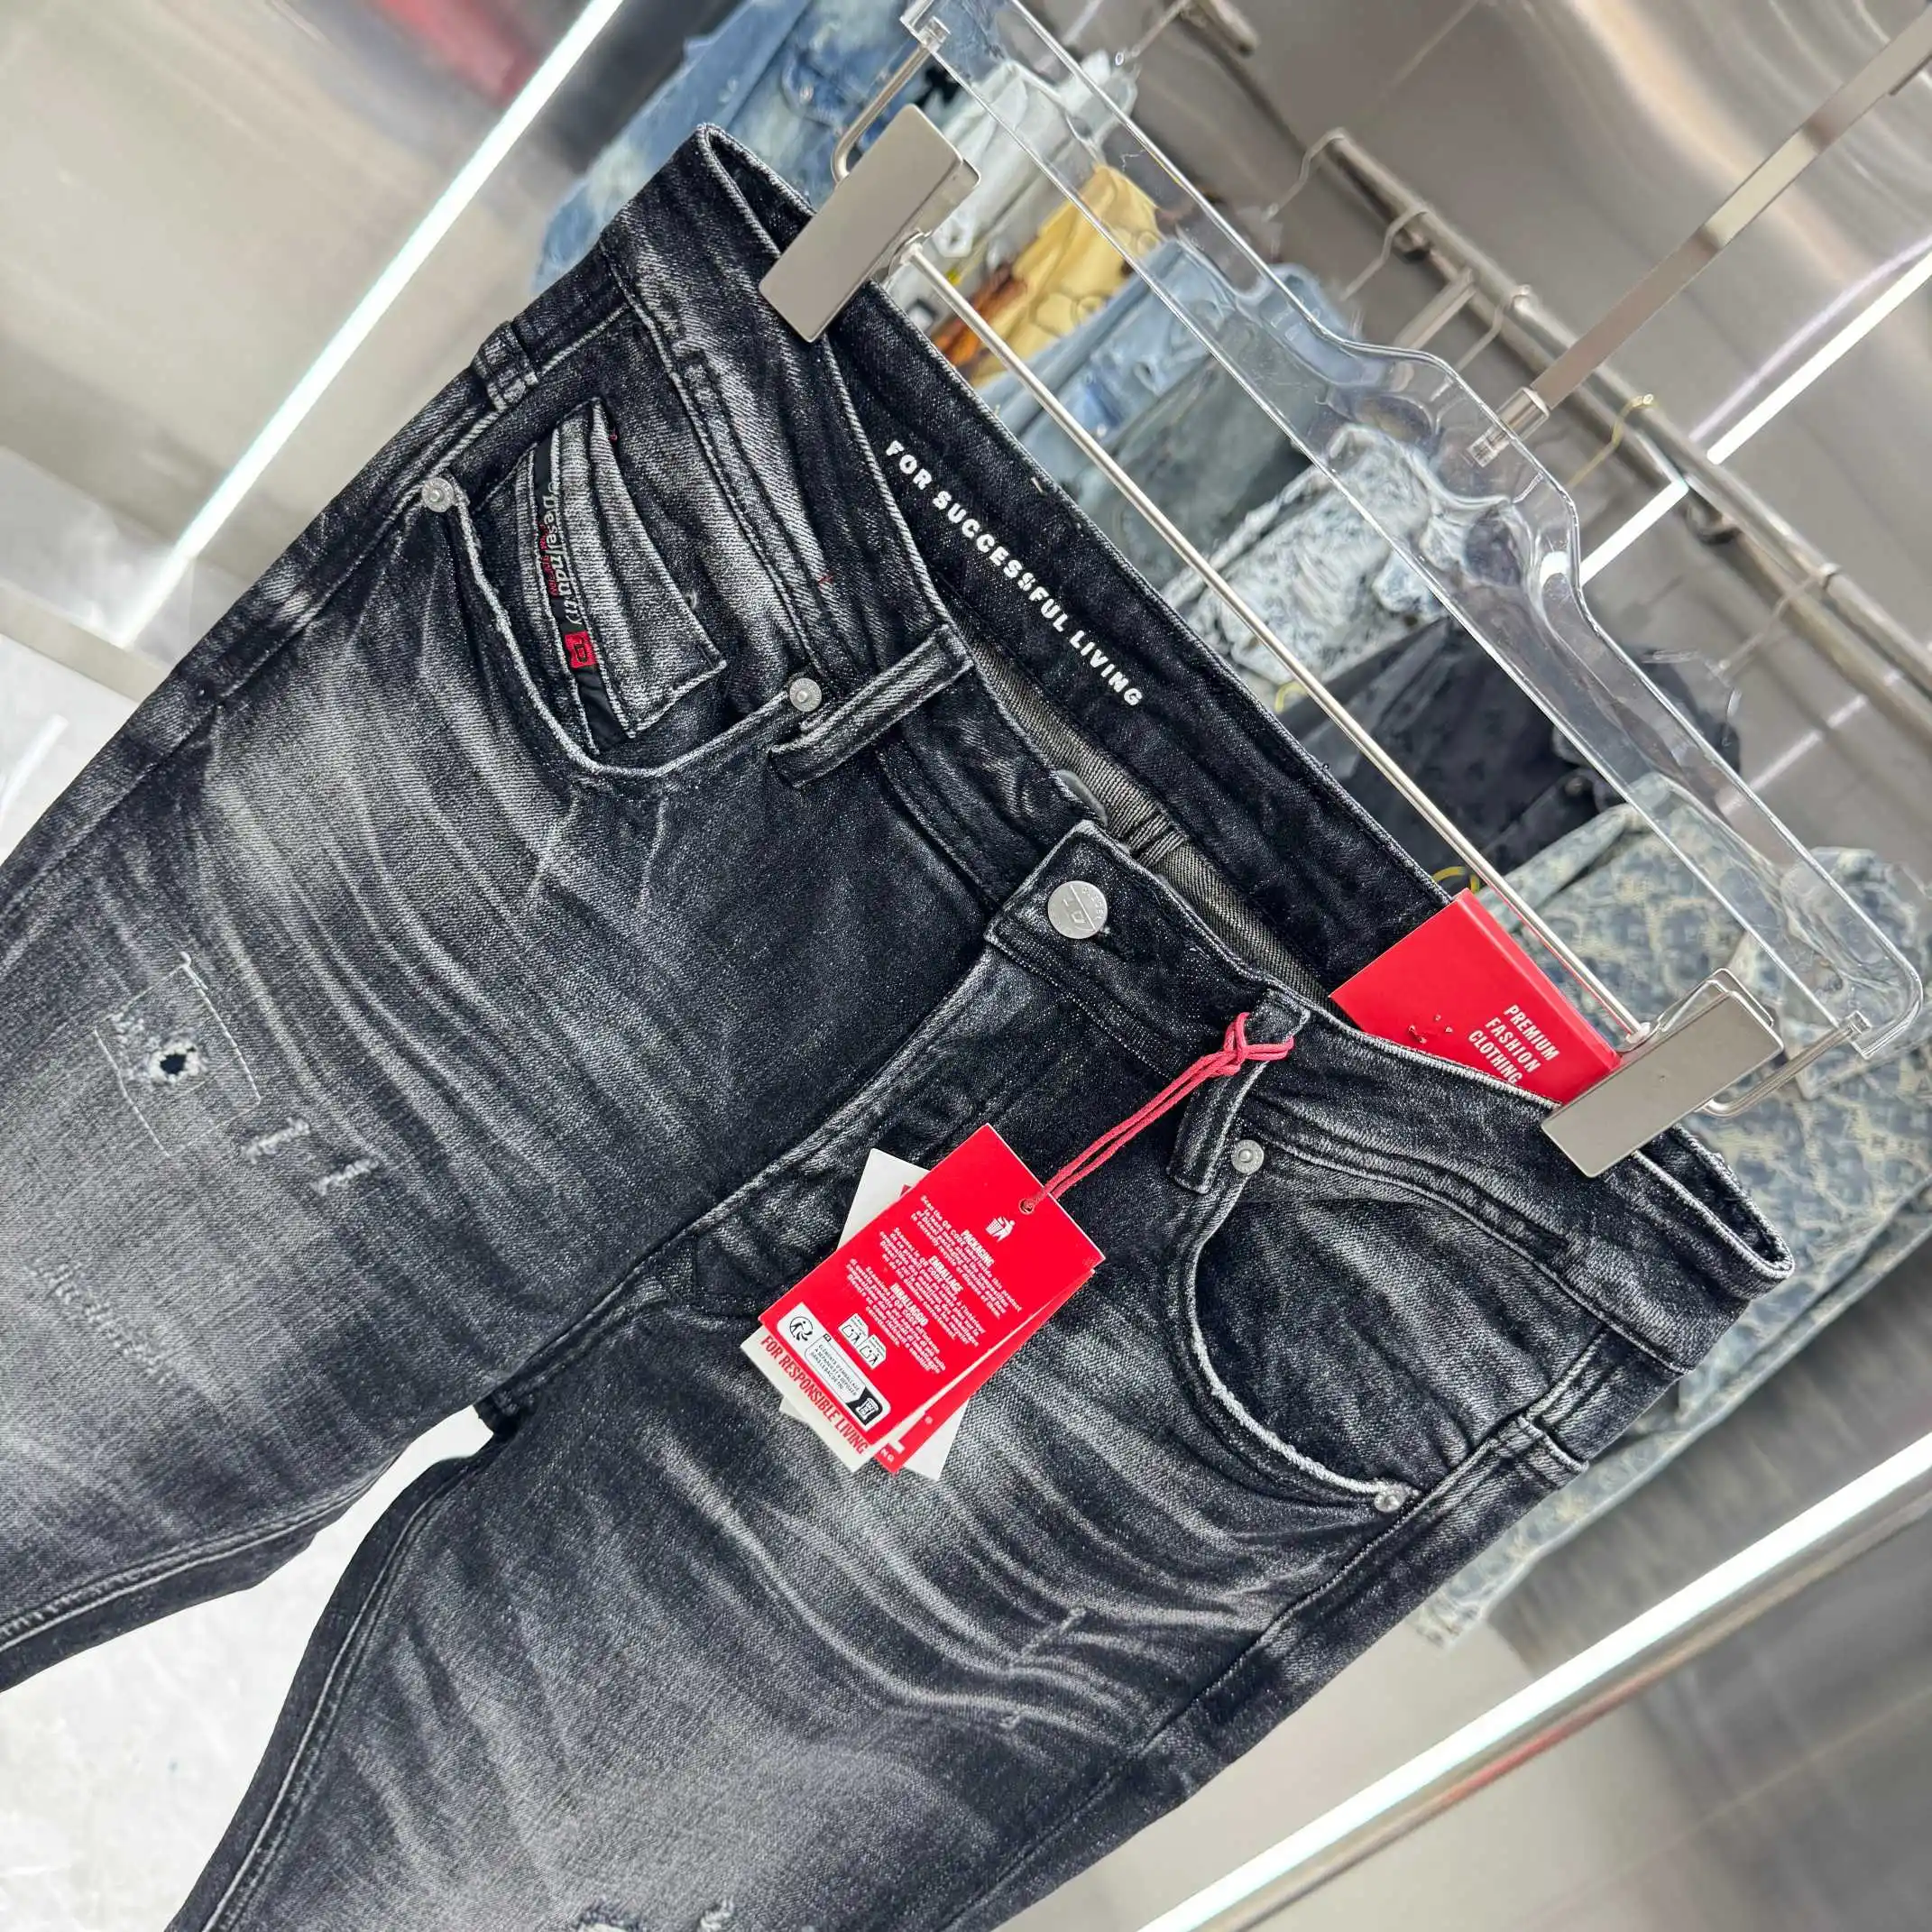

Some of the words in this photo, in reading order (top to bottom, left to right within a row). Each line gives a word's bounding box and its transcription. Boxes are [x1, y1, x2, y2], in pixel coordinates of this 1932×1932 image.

[886, 440, 932, 490] FOR
[933, 491, 1068, 632] SUCCESSFUL
[1070, 630, 1143, 706] LIVING
[1467, 1029, 1523, 1084] CLOTHING
[1485, 1017, 1541, 1072] FASHION
[1503, 1004, 1559, 1061] PREMIUM
[927, 1254, 964, 1294] EMBALLAGE
[960, 1228, 996, 1267] PACKAGING
[760, 1335, 784, 1359] FOR
[778, 1353, 841, 1421] RESPONSIBLE
[834, 1416, 869, 1454] LIVING
